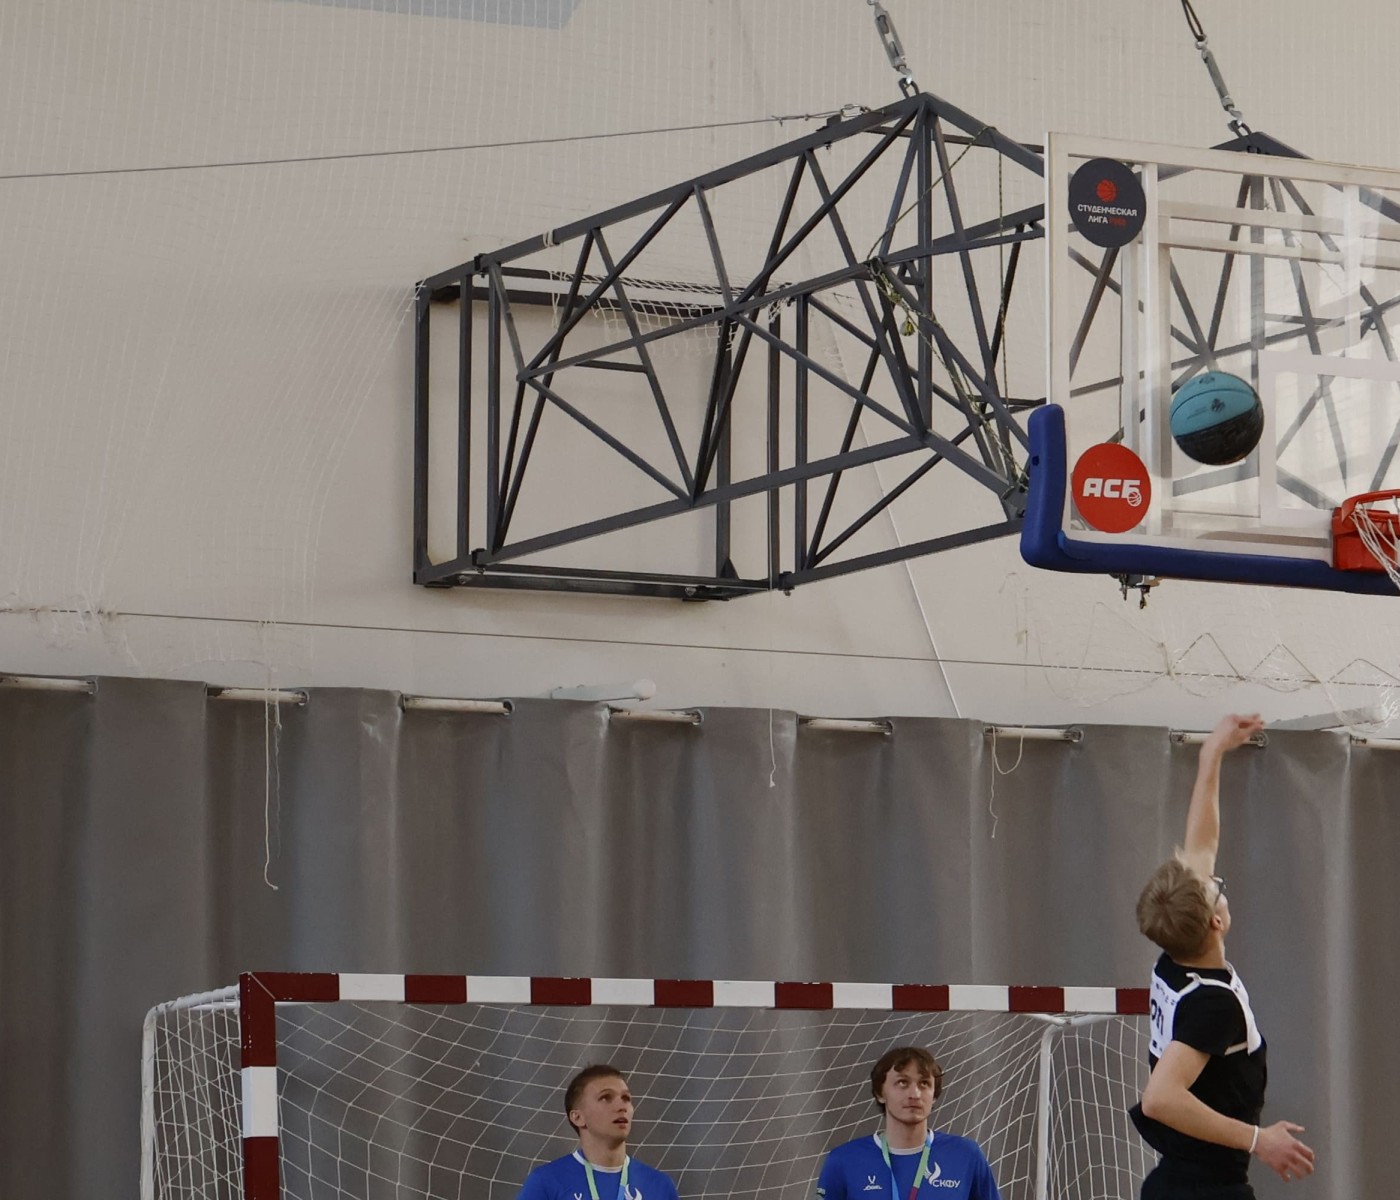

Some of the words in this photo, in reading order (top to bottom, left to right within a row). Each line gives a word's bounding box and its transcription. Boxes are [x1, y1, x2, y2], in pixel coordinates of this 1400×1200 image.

[1077, 203, 1138, 217] СТУДЕНЧЕСКАЯ
[1088, 215, 1108, 224] ЛИГА
[1082, 477, 1142, 502] АСБ
[932, 1179, 961, 1189] СКФУ
